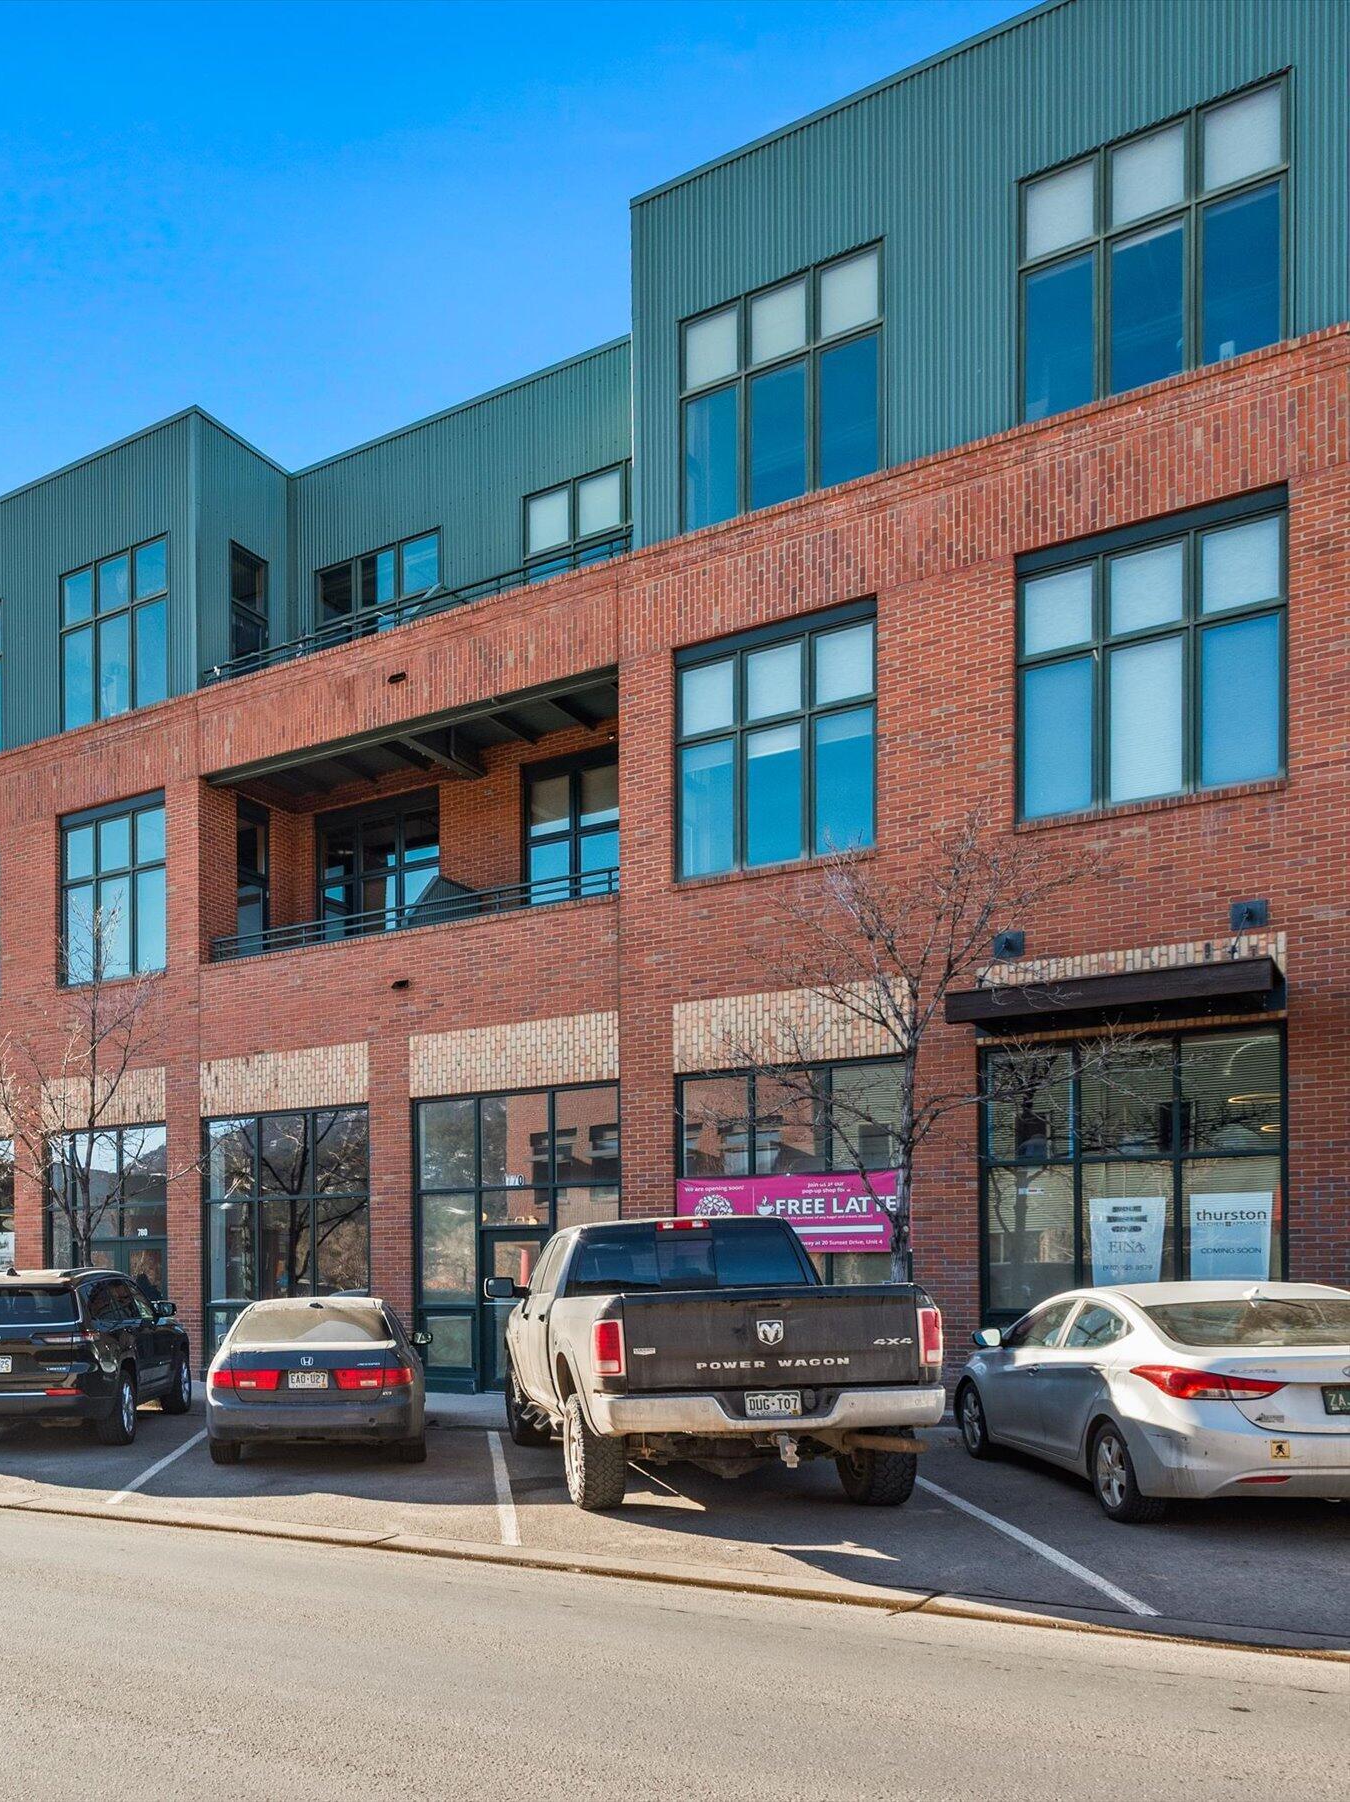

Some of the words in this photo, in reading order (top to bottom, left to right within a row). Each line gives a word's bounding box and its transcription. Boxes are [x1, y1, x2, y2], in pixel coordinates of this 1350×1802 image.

[775, 1198, 825, 1215] FREE
[832, 1195, 897, 1213] LATTE
[1196, 1209, 1267, 1221] thurston
[696, 1360, 766, 1370] POWER
[778, 1357, 850, 1367] WAGON
[1329, 1393, 1350, 1406] ZA
